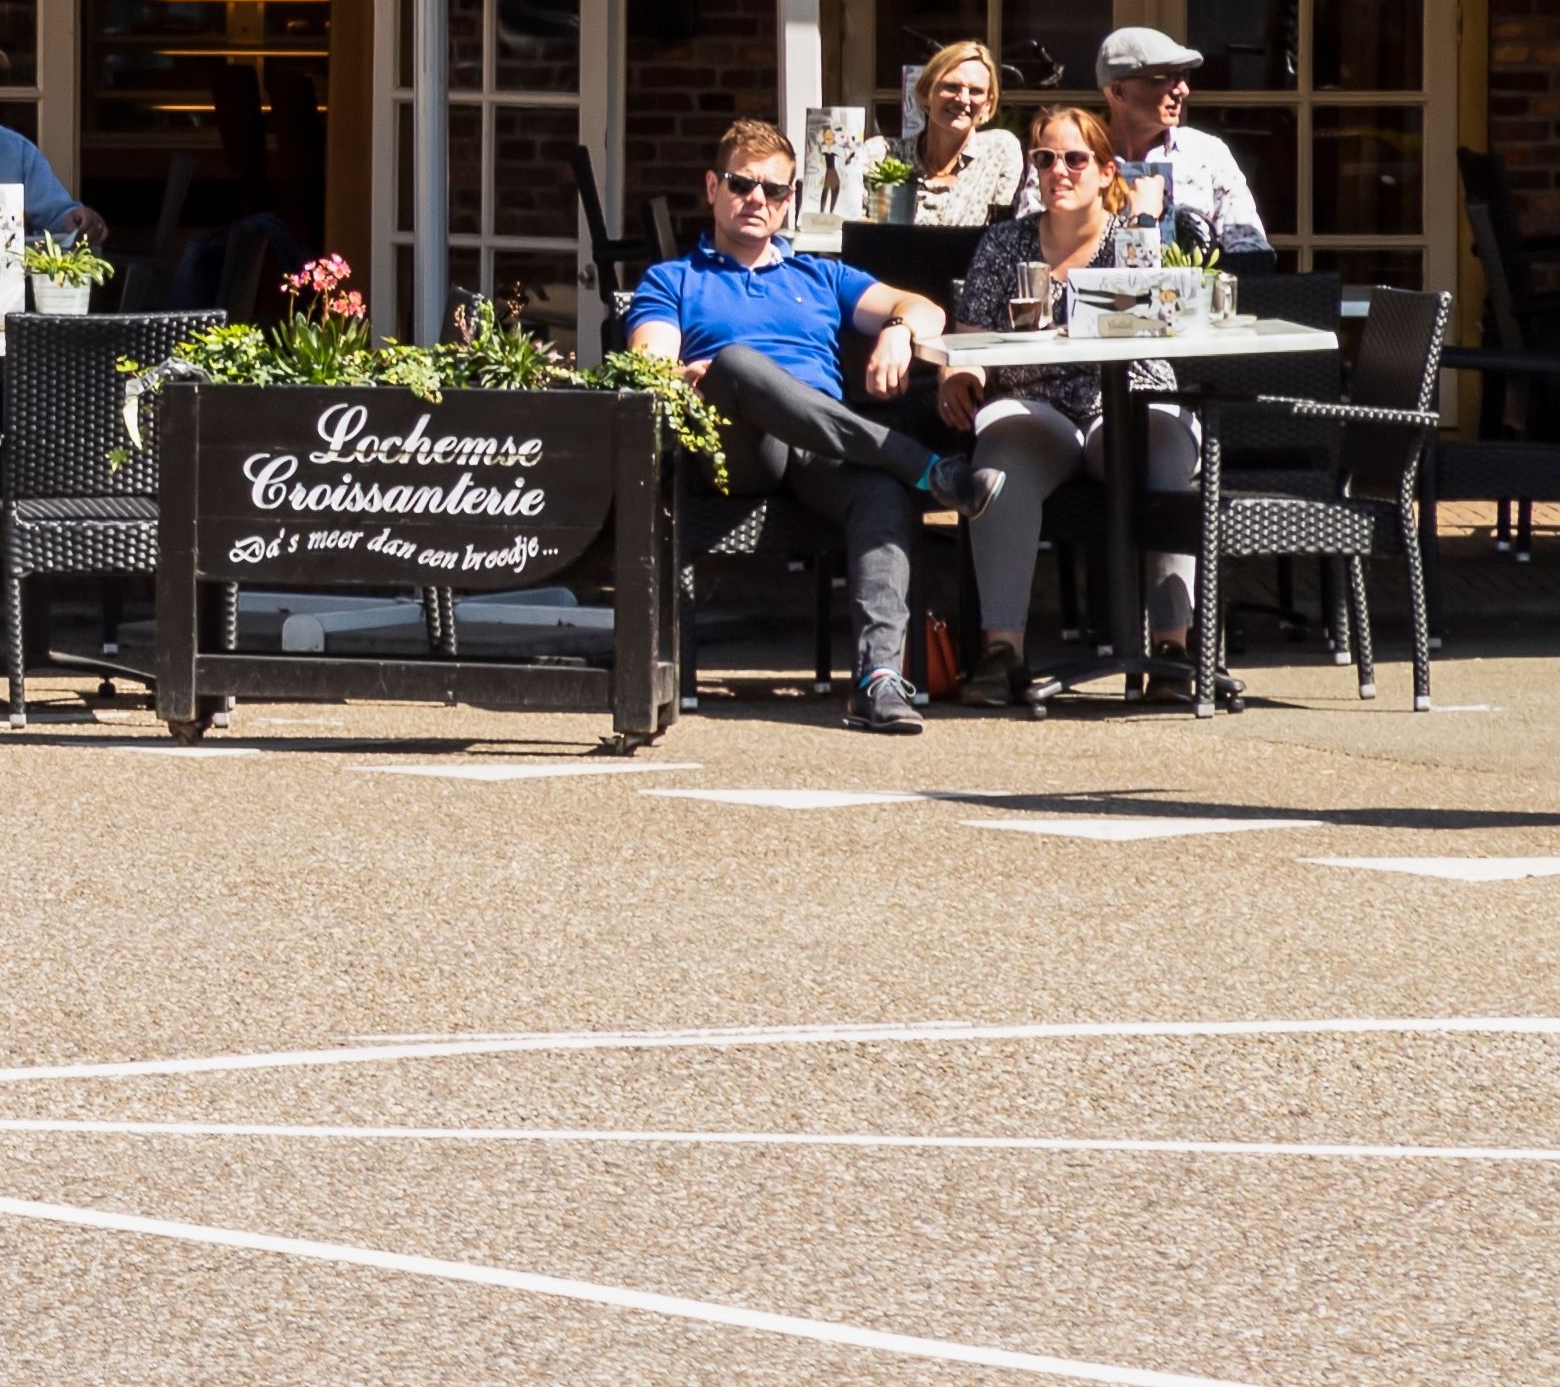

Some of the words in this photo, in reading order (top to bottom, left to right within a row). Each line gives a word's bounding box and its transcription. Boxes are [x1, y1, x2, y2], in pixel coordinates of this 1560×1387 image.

[309, 403, 543, 467] Lochemse
[242, 453, 546, 516] Croissanterie
[228, 527, 300, 563] Da's
[307, 529, 364, 550] meer
[366, 528, 417, 559] dan
[417, 548, 459, 570] een
